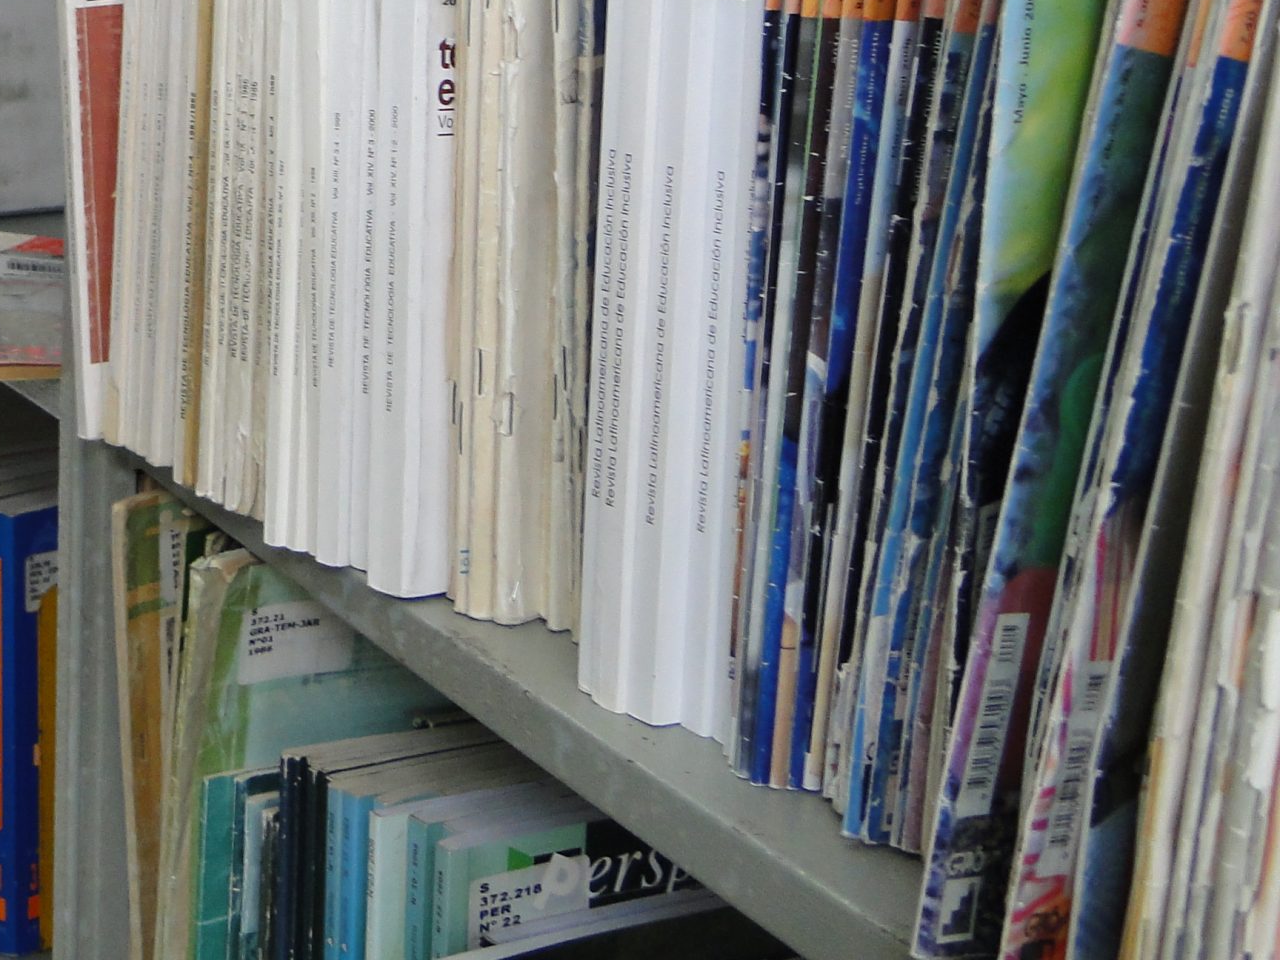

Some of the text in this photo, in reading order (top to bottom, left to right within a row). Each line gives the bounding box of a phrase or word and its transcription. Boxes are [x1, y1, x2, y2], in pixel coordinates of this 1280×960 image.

[1018, 27, 1033, 66] Junio
[1013, 83, 1028, 125] Mayo
[591, 149, 617, 498] Revista Latinoamericana de Educación Inclusiva
[604, 152, 633, 507] Revista Latinoamericana de Educación Inclusiva
[644, 165, 675, 525] Revista Latinoamericana de Educación Inclusiva
[695, 170, 726, 534] Revista Latinoamericana de Educación Inclusiva
[480, 883, 489, 893] S
[480, 883, 542, 907] 372.218
[479, 904, 512, 920] PER
[502, 914, 521, 928] 22
